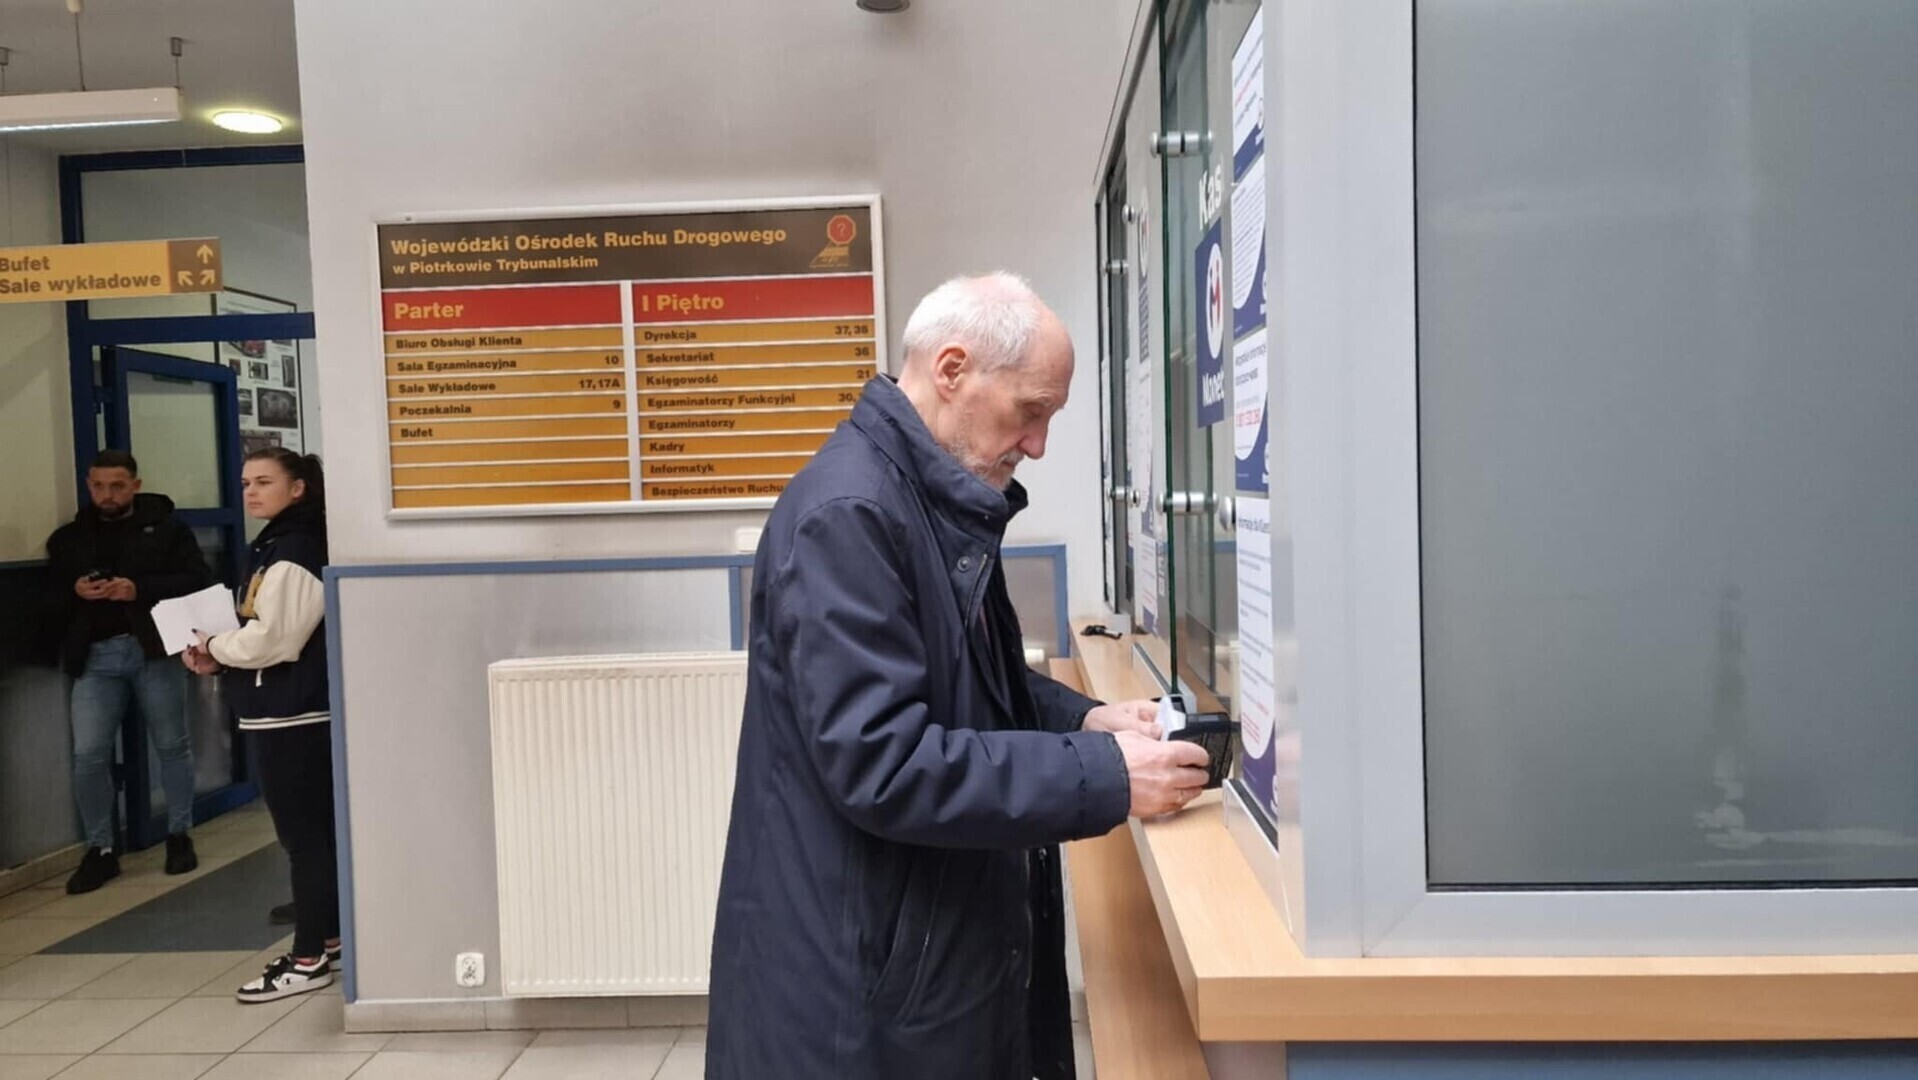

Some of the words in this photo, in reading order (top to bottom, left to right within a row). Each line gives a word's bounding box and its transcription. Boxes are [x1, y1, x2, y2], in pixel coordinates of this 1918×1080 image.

[391, 235, 509, 256] Wojewódzki
[515, 233, 598, 250] Ośrodek
[604, 230, 667, 248] Ruchu
[674, 228, 787, 246] Drogowego
[0, 256, 50, 272] Bufet
[393, 264, 404, 274] w
[410, 260, 492, 274] Piotrkowie
[497, 256, 599, 272] Trybunalskim
[0, 278, 41, 294] Sale
[48, 274, 161, 293] wykładowe
[642, 296, 649, 311] I
[657, 294, 725, 315] Piętro
[394, 303, 464, 319] Parter
[645, 330, 697, 341] Dyrekcja
[396, 340, 427, 348] Biuro
[431, 338, 475, 348] Obsługi
[479, 337, 522, 346] Klienta
[605, 356, 619, 365] 10
[647, 352, 714, 363] Sekretariat
[398, 362, 423, 371] Sala
[427, 360, 516, 371] Egzaminacyjna
[856, 370, 870, 379] 21
[647, 374, 718, 387] Księgowość
[399, 384, 424, 393] Sale
[428, 382, 496, 393] Wykładowe
[613, 401, 621, 409] 9
[648, 397, 734, 408] Egzaminatorzy
[738, 393, 796, 406] Funkcyjni
[400, 405, 472, 415] Poczekalnia
[649, 419, 735, 431] Egzaminatorzy
[401, 428, 433, 437] Bufet
[650, 442, 684, 452] Kadry
[650, 464, 714, 474] Informatyk
[652, 485, 744, 496] Bezpieczeństwo
